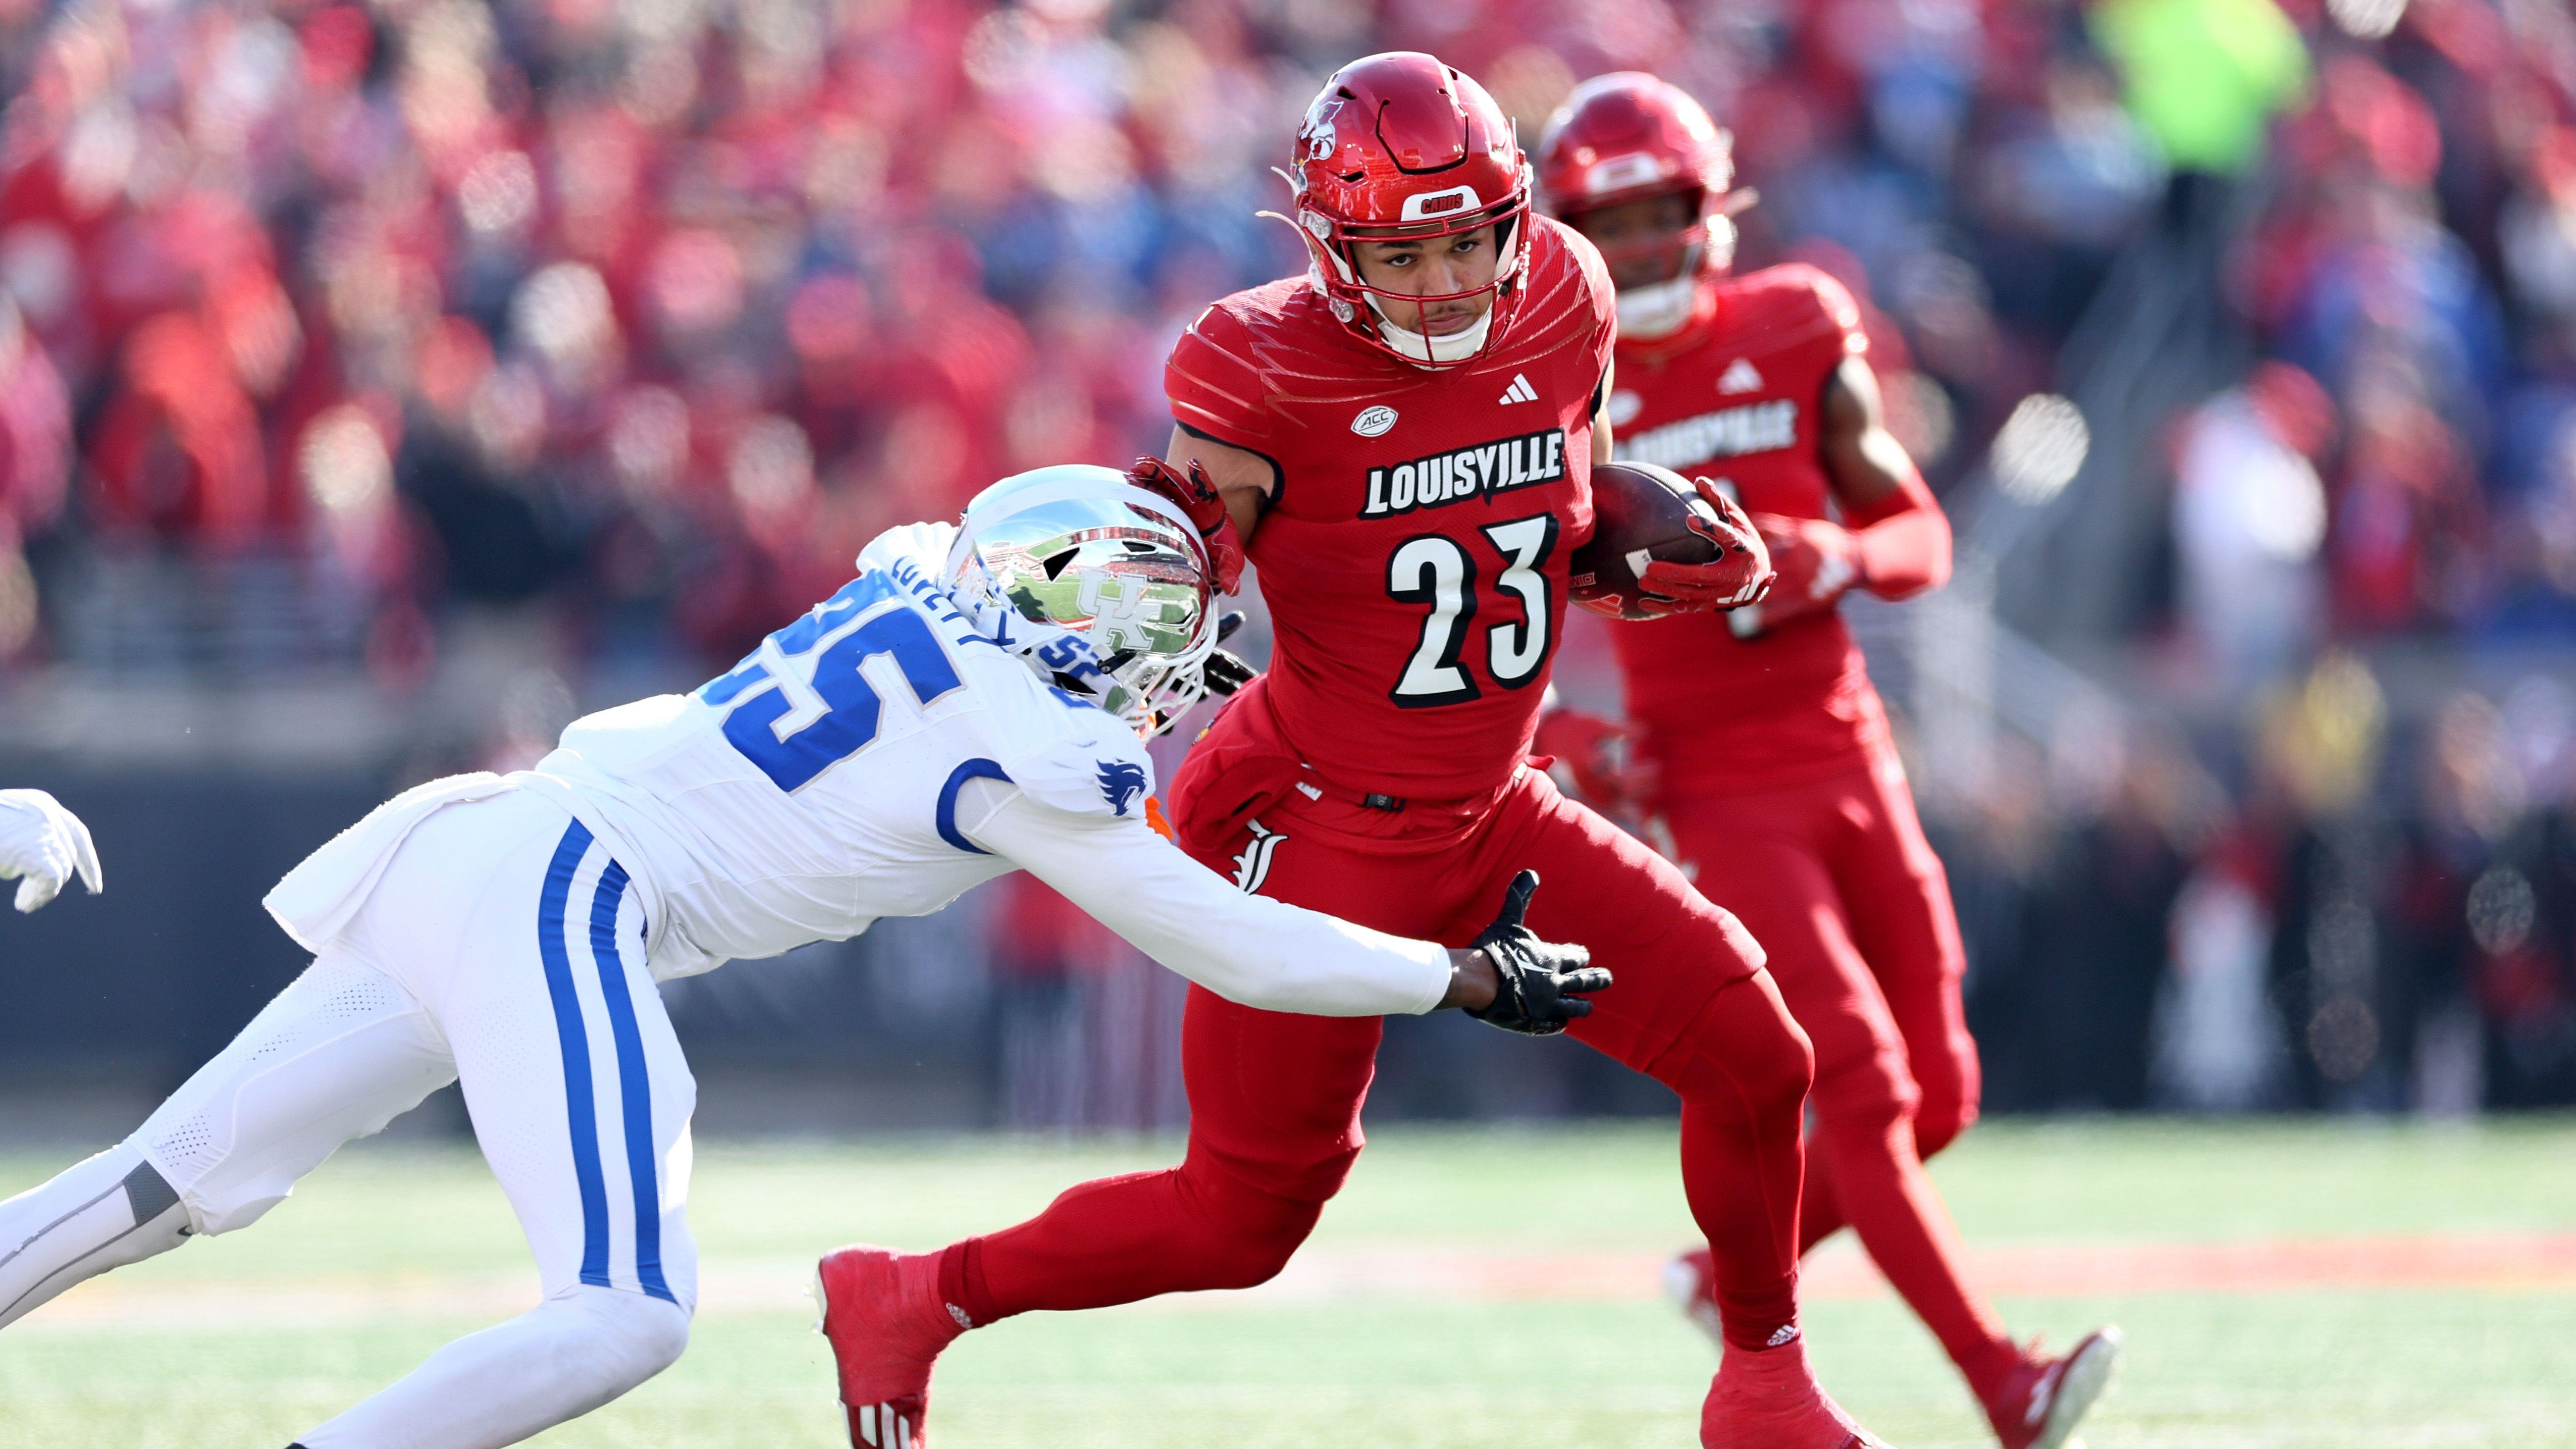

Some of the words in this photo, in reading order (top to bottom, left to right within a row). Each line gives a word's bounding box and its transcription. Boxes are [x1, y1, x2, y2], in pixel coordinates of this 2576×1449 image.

[1421, 193, 1463, 215] CARDS
[1360, 410, 1390, 429] ACC
[1362, 429, 1564, 516] LOUISVILLE
[1077, 566, 1163, 651] UK
[1388, 514, 1557, 703] 23
